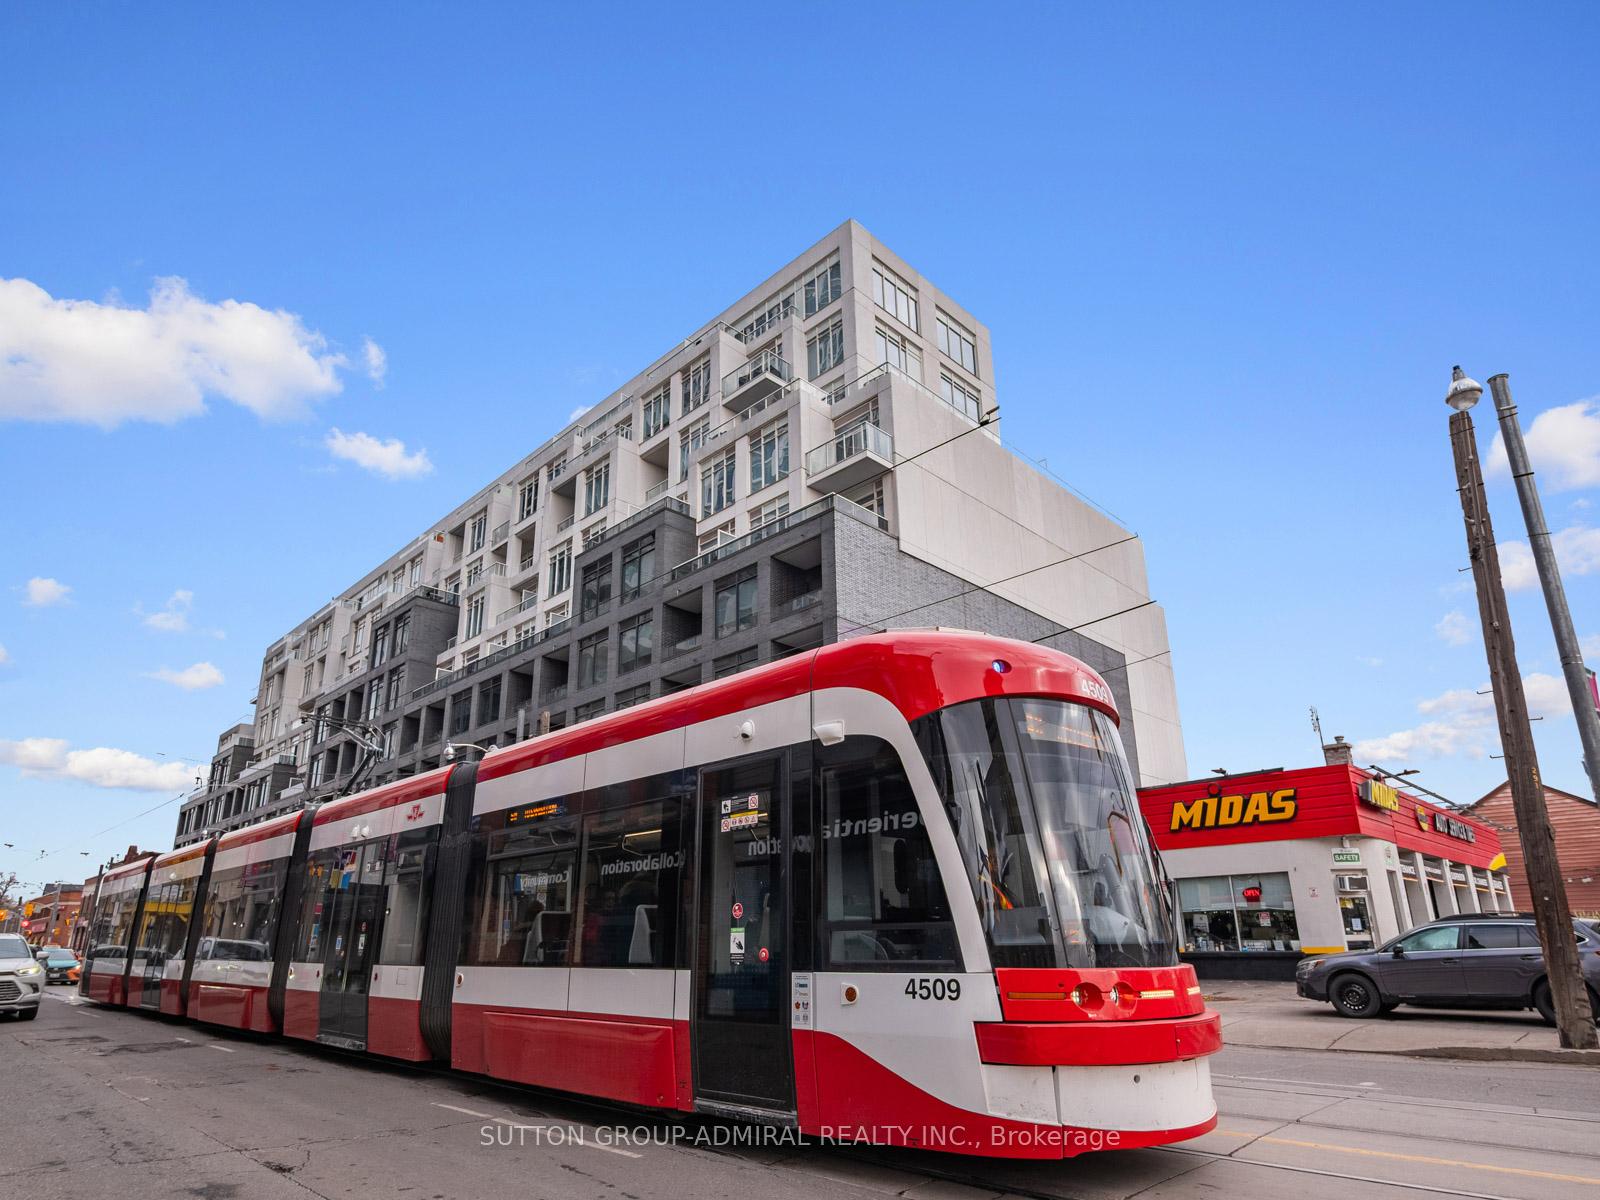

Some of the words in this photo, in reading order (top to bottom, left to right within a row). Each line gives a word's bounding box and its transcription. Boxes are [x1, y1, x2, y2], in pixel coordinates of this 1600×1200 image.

[1372, 780, 1399, 811] MIDAS
[1170, 788, 1296, 831] MIDAS
[1244, 889, 1260, 897] OPEN
[905, 978, 961, 1001] 4509
